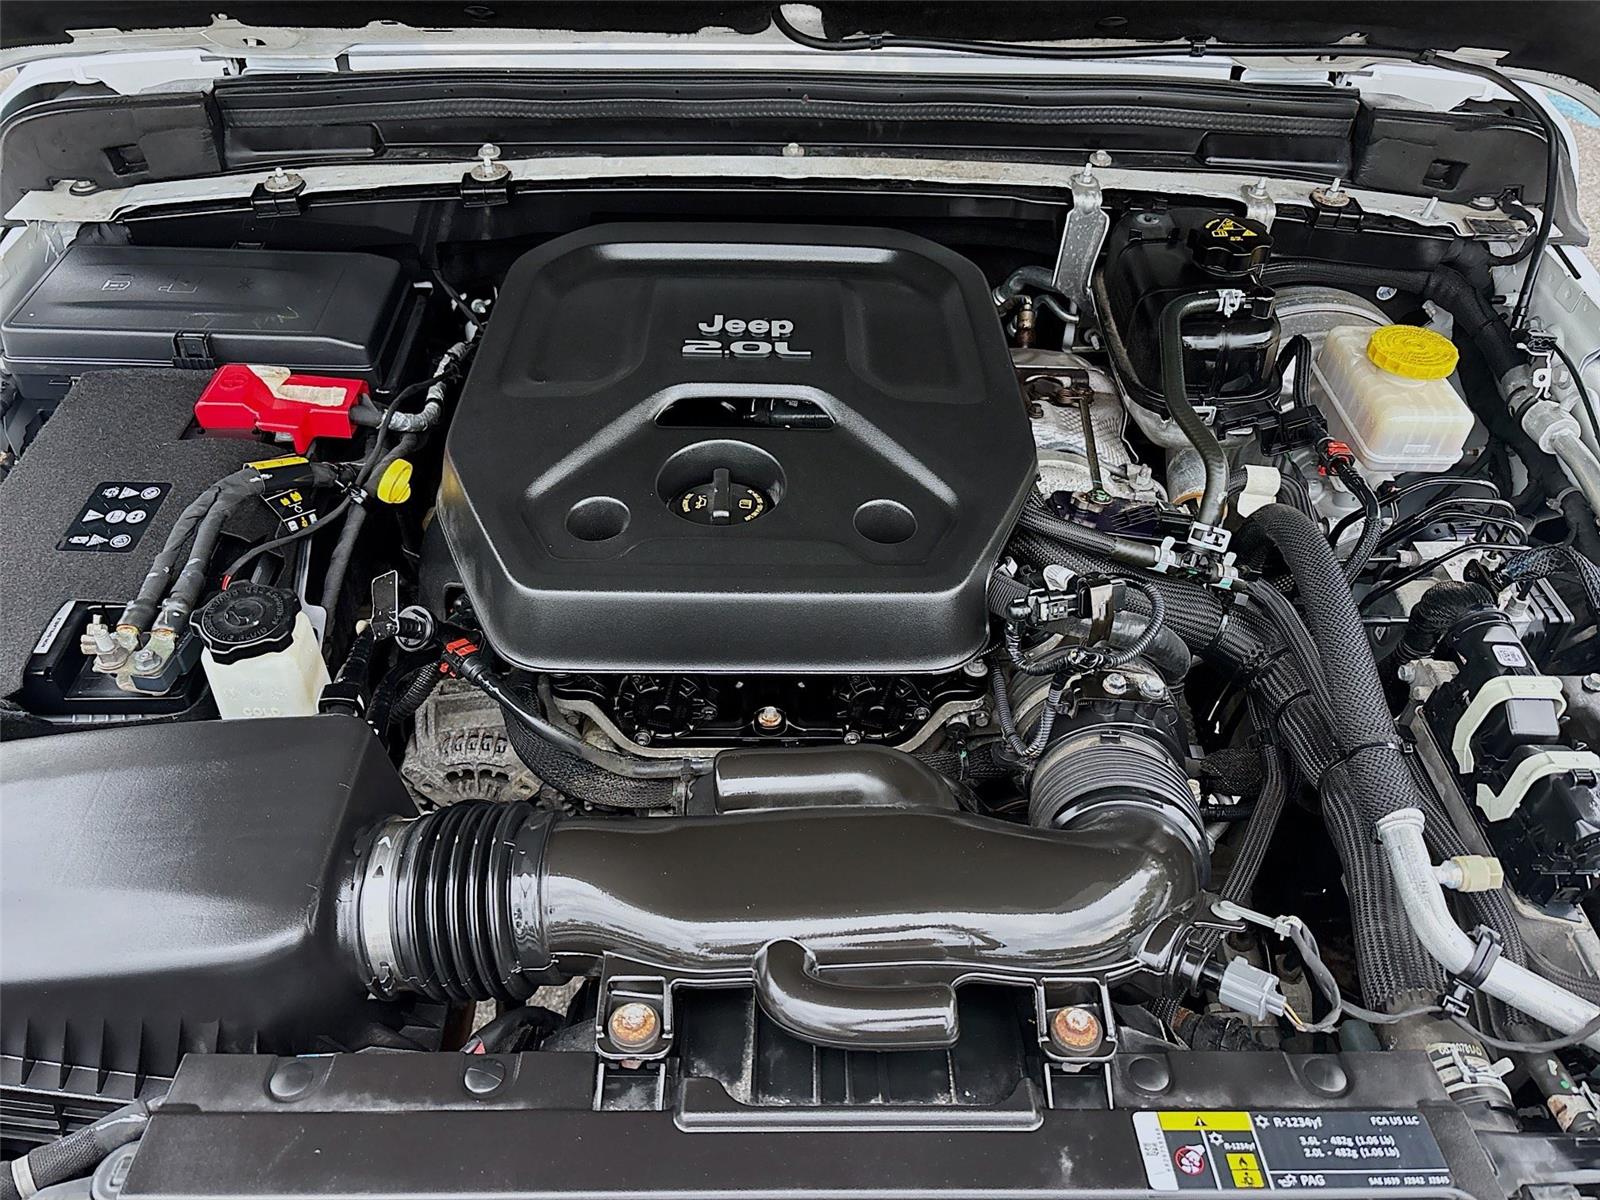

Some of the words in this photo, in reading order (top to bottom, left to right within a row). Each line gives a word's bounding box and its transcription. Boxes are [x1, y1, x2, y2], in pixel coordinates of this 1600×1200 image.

[698, 315, 793, 338] Jeep
[682, 340, 811, 358] 2.0L
[1370, 1116, 1389, 1126] FCA
[1389, 1116, 1403, 1125] US
[1403, 1116, 1420, 1125] LLC
[1303, 1148, 1325, 1158] 2.0L
[1300, 1174, 1326, 1187] PAG
